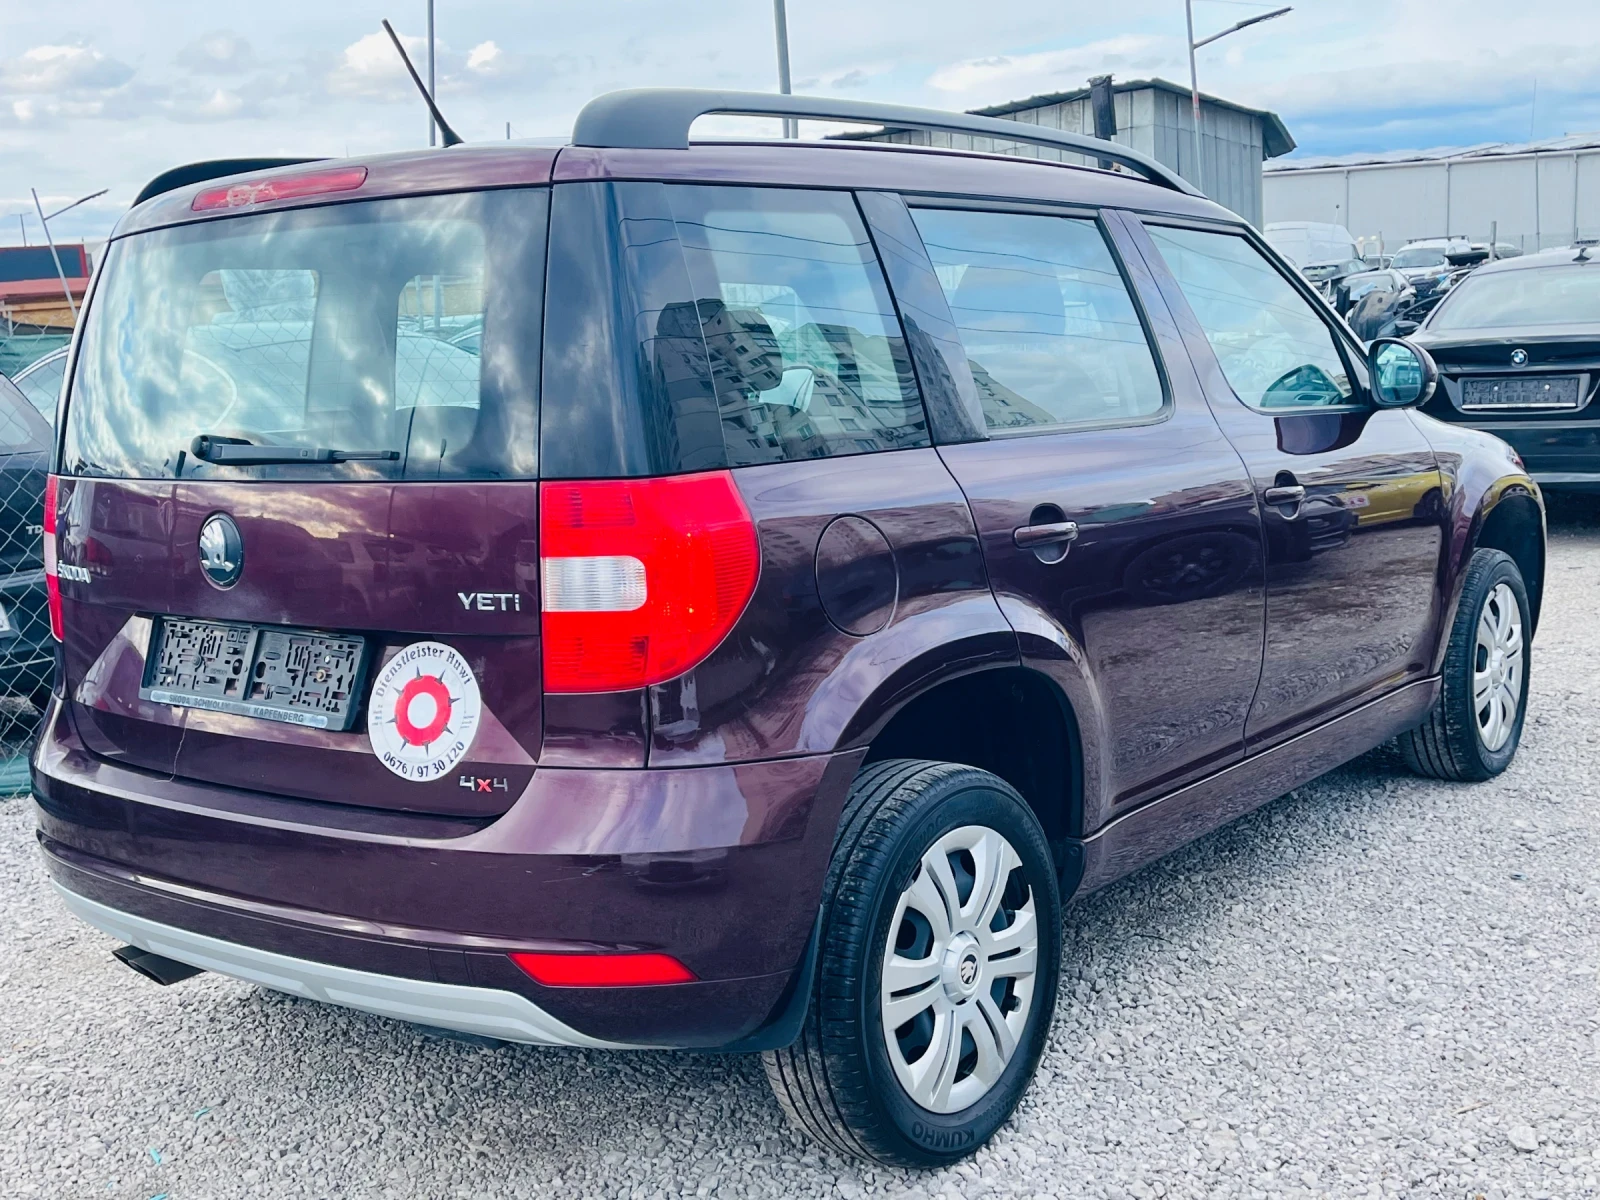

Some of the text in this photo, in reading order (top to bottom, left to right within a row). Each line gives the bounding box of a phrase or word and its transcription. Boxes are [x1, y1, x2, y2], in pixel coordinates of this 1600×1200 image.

[376, 646, 473, 697] Dienstleister Huwi
[253, 707, 305, 723] KAPFENBERG
[383, 752, 408, 774] 0676
[417, 766, 429, 777] 97
[432, 760, 446, 774] 30
[446, 741, 465, 763] 120
[912, 1120, 975, 1148] KUMHO
